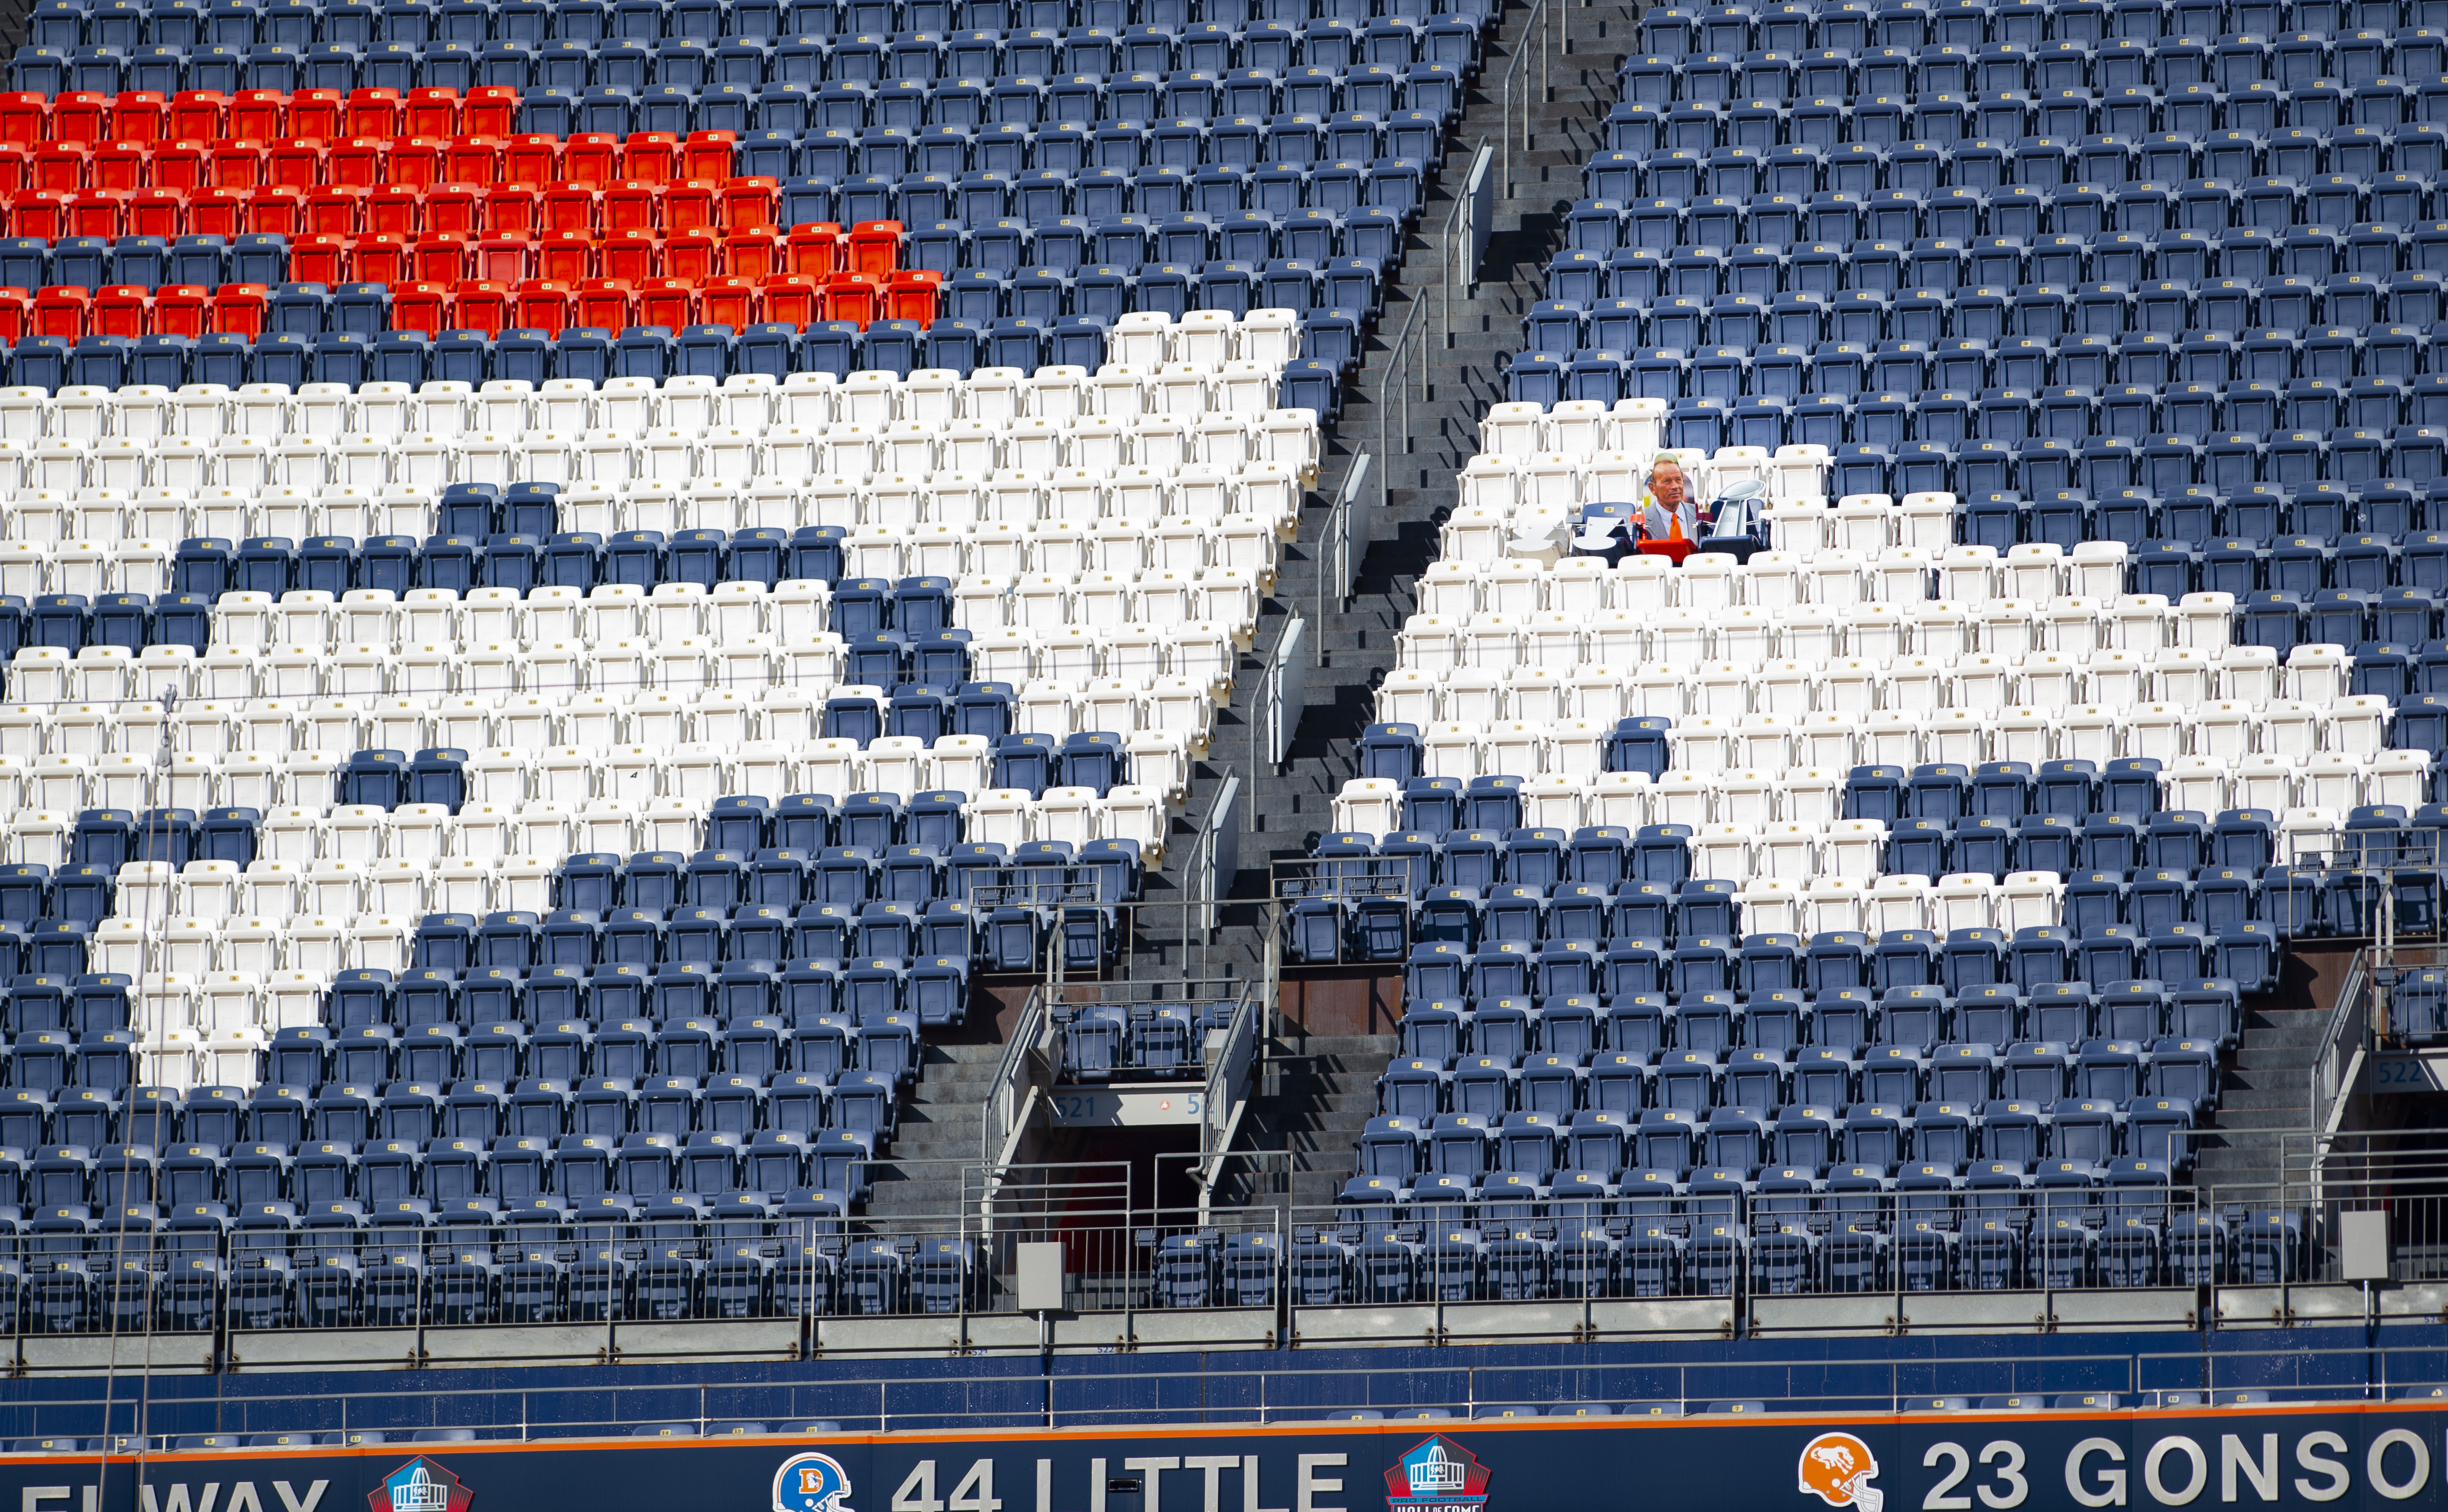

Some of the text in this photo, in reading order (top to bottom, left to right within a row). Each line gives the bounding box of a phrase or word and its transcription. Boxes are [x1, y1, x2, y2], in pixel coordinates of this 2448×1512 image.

[2378, 1061, 2422, 1084] 522
[1055, 1096, 1094, 1118] 521
[892, 1459, 1002, 1512] 44
[1922, 1428, 2448, 1510] 23 GONSO
